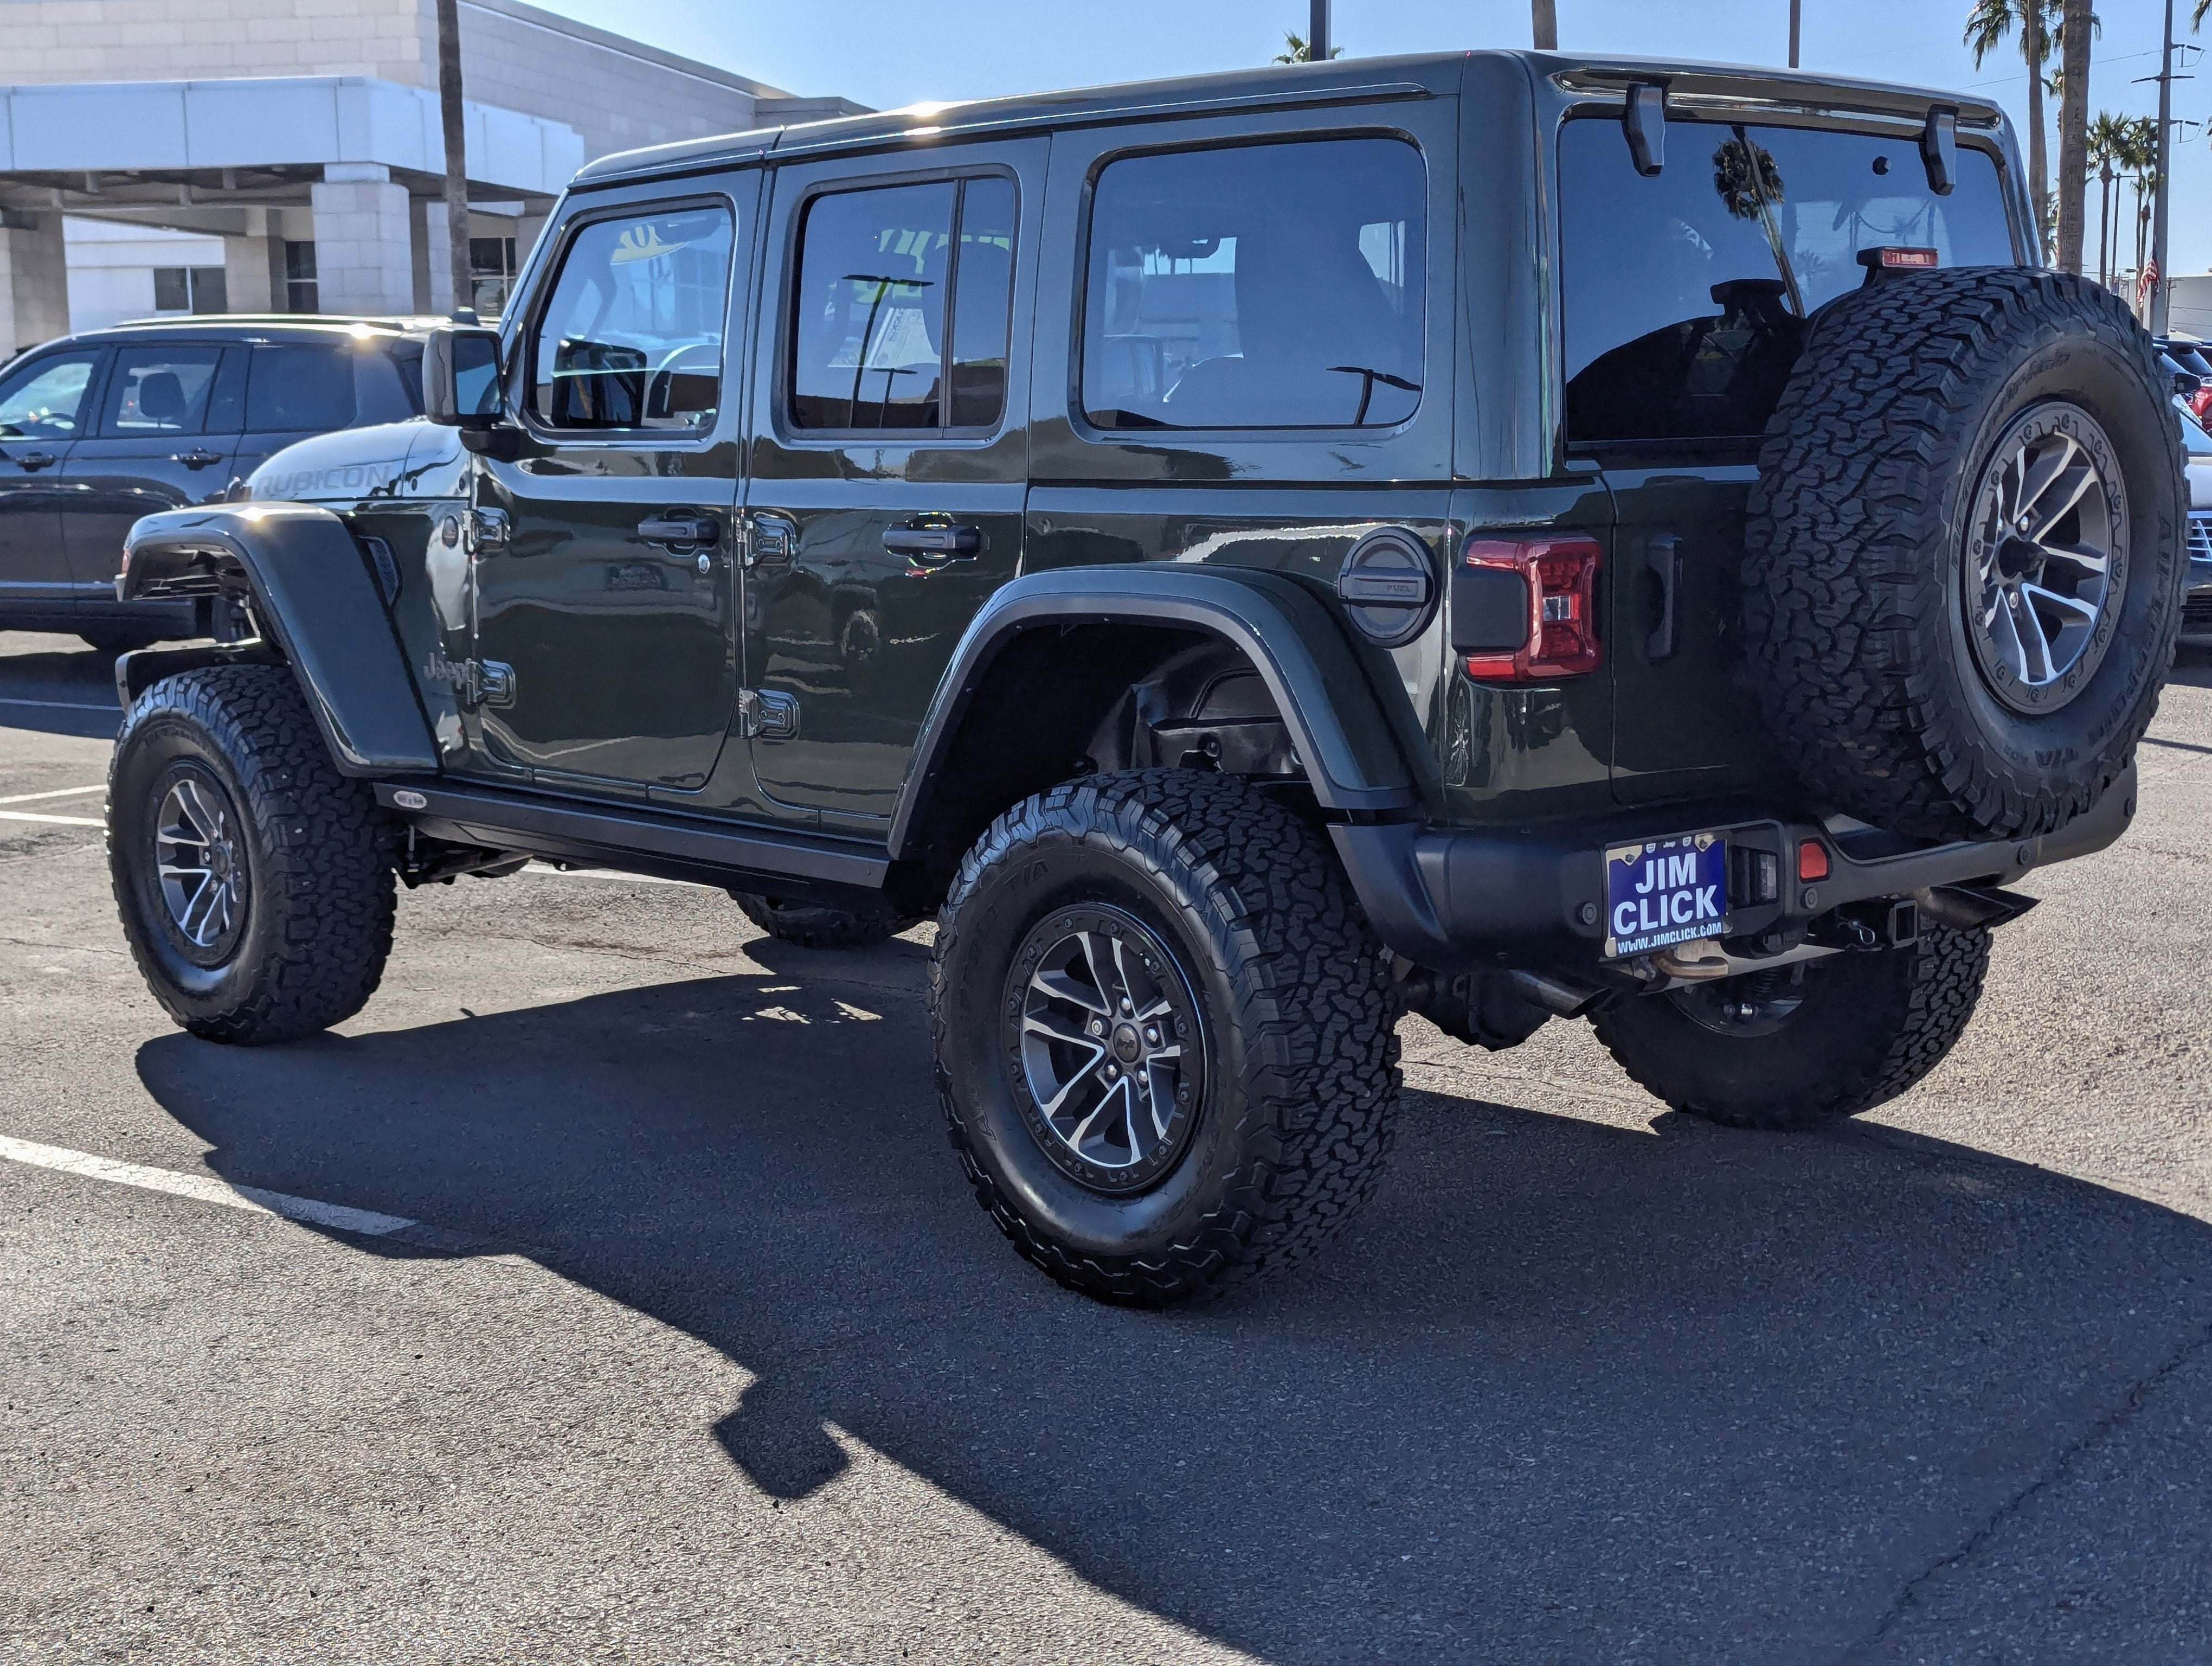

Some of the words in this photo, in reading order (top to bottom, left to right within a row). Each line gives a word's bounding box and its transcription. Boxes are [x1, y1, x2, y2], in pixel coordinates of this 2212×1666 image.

[255, 465, 390, 496] RUBICON
[1387, 584, 1411, 593] FUEL
[422, 652, 470, 690] Jeep
[1635, 852, 1696, 894] JIM
[1613, 885, 1719, 935] CLICK
[1618, 922, 1722, 954] WWW.JIMCLICK.COM
